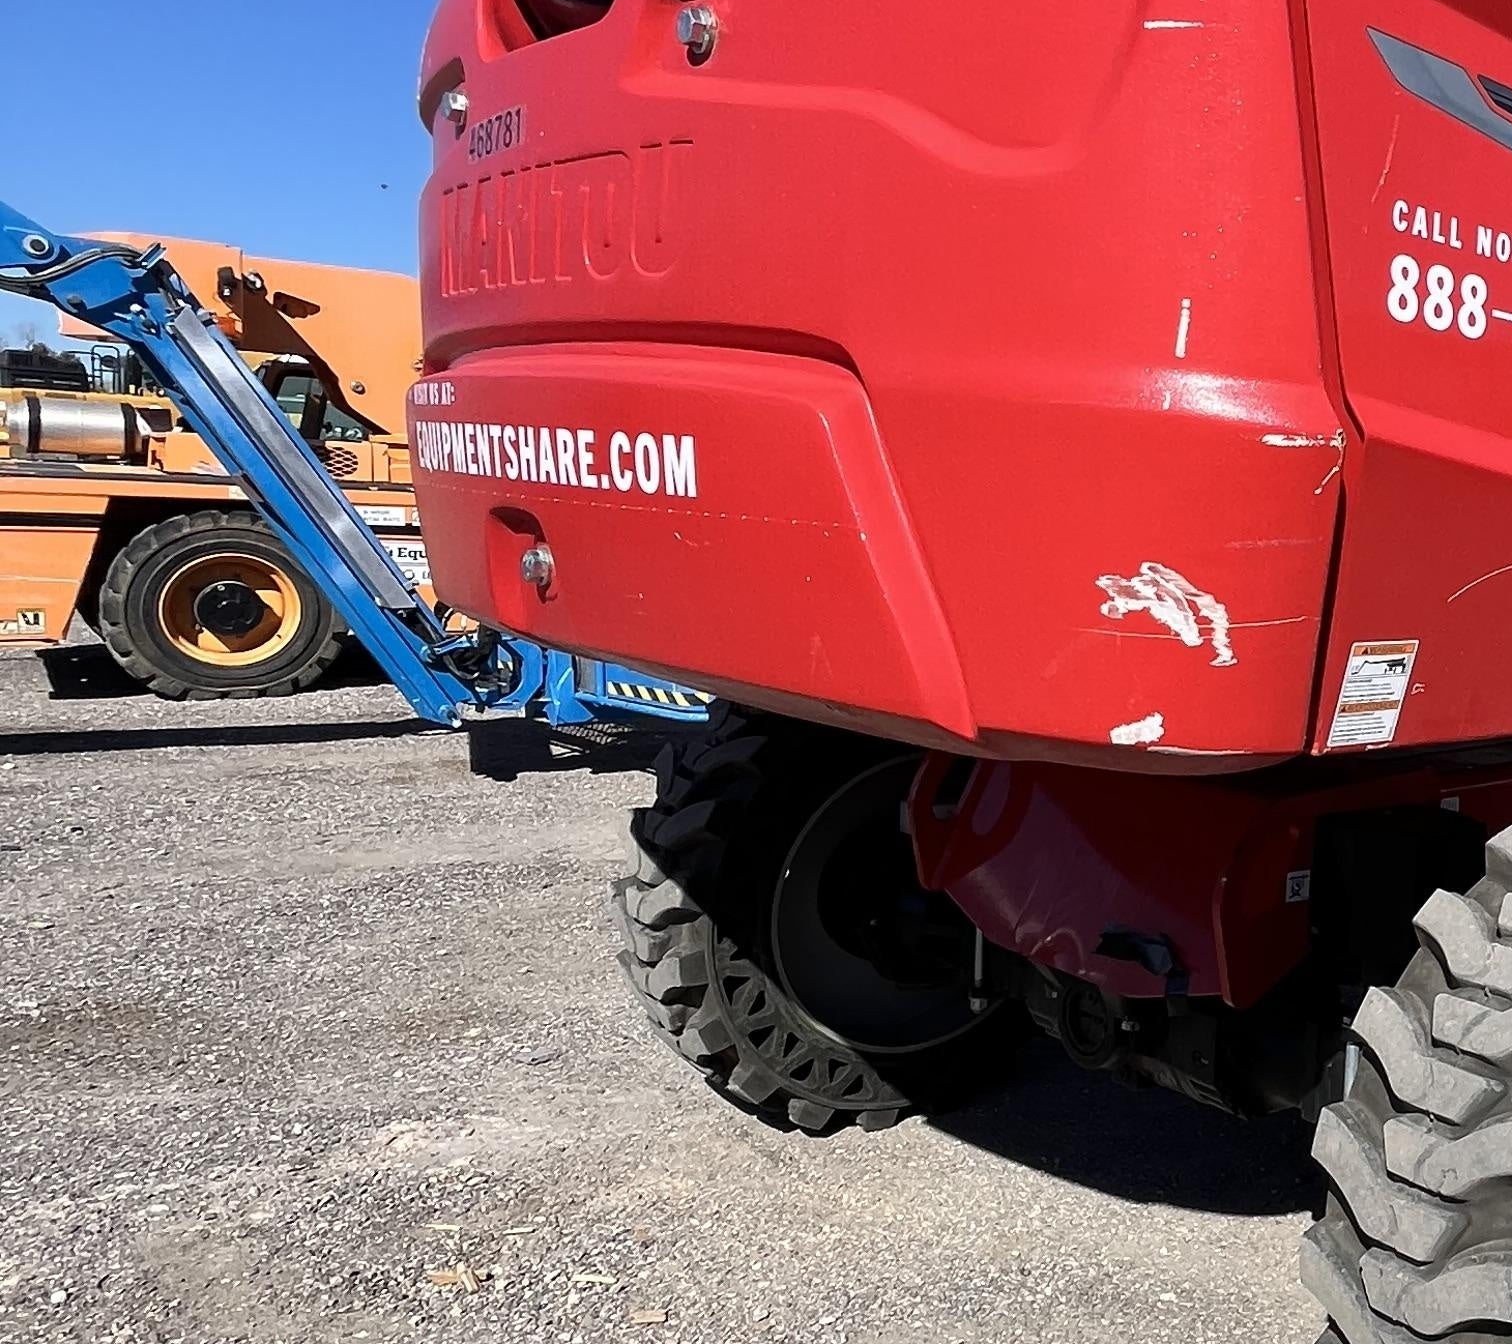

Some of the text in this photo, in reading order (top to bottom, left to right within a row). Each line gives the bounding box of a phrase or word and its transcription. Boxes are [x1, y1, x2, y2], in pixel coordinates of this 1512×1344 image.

[440, 138, 695, 298] MANITOU
[1392, 199, 1463, 250] CALL
[415, 421, 697, 498] EQUIPMENTSHARE.COM
